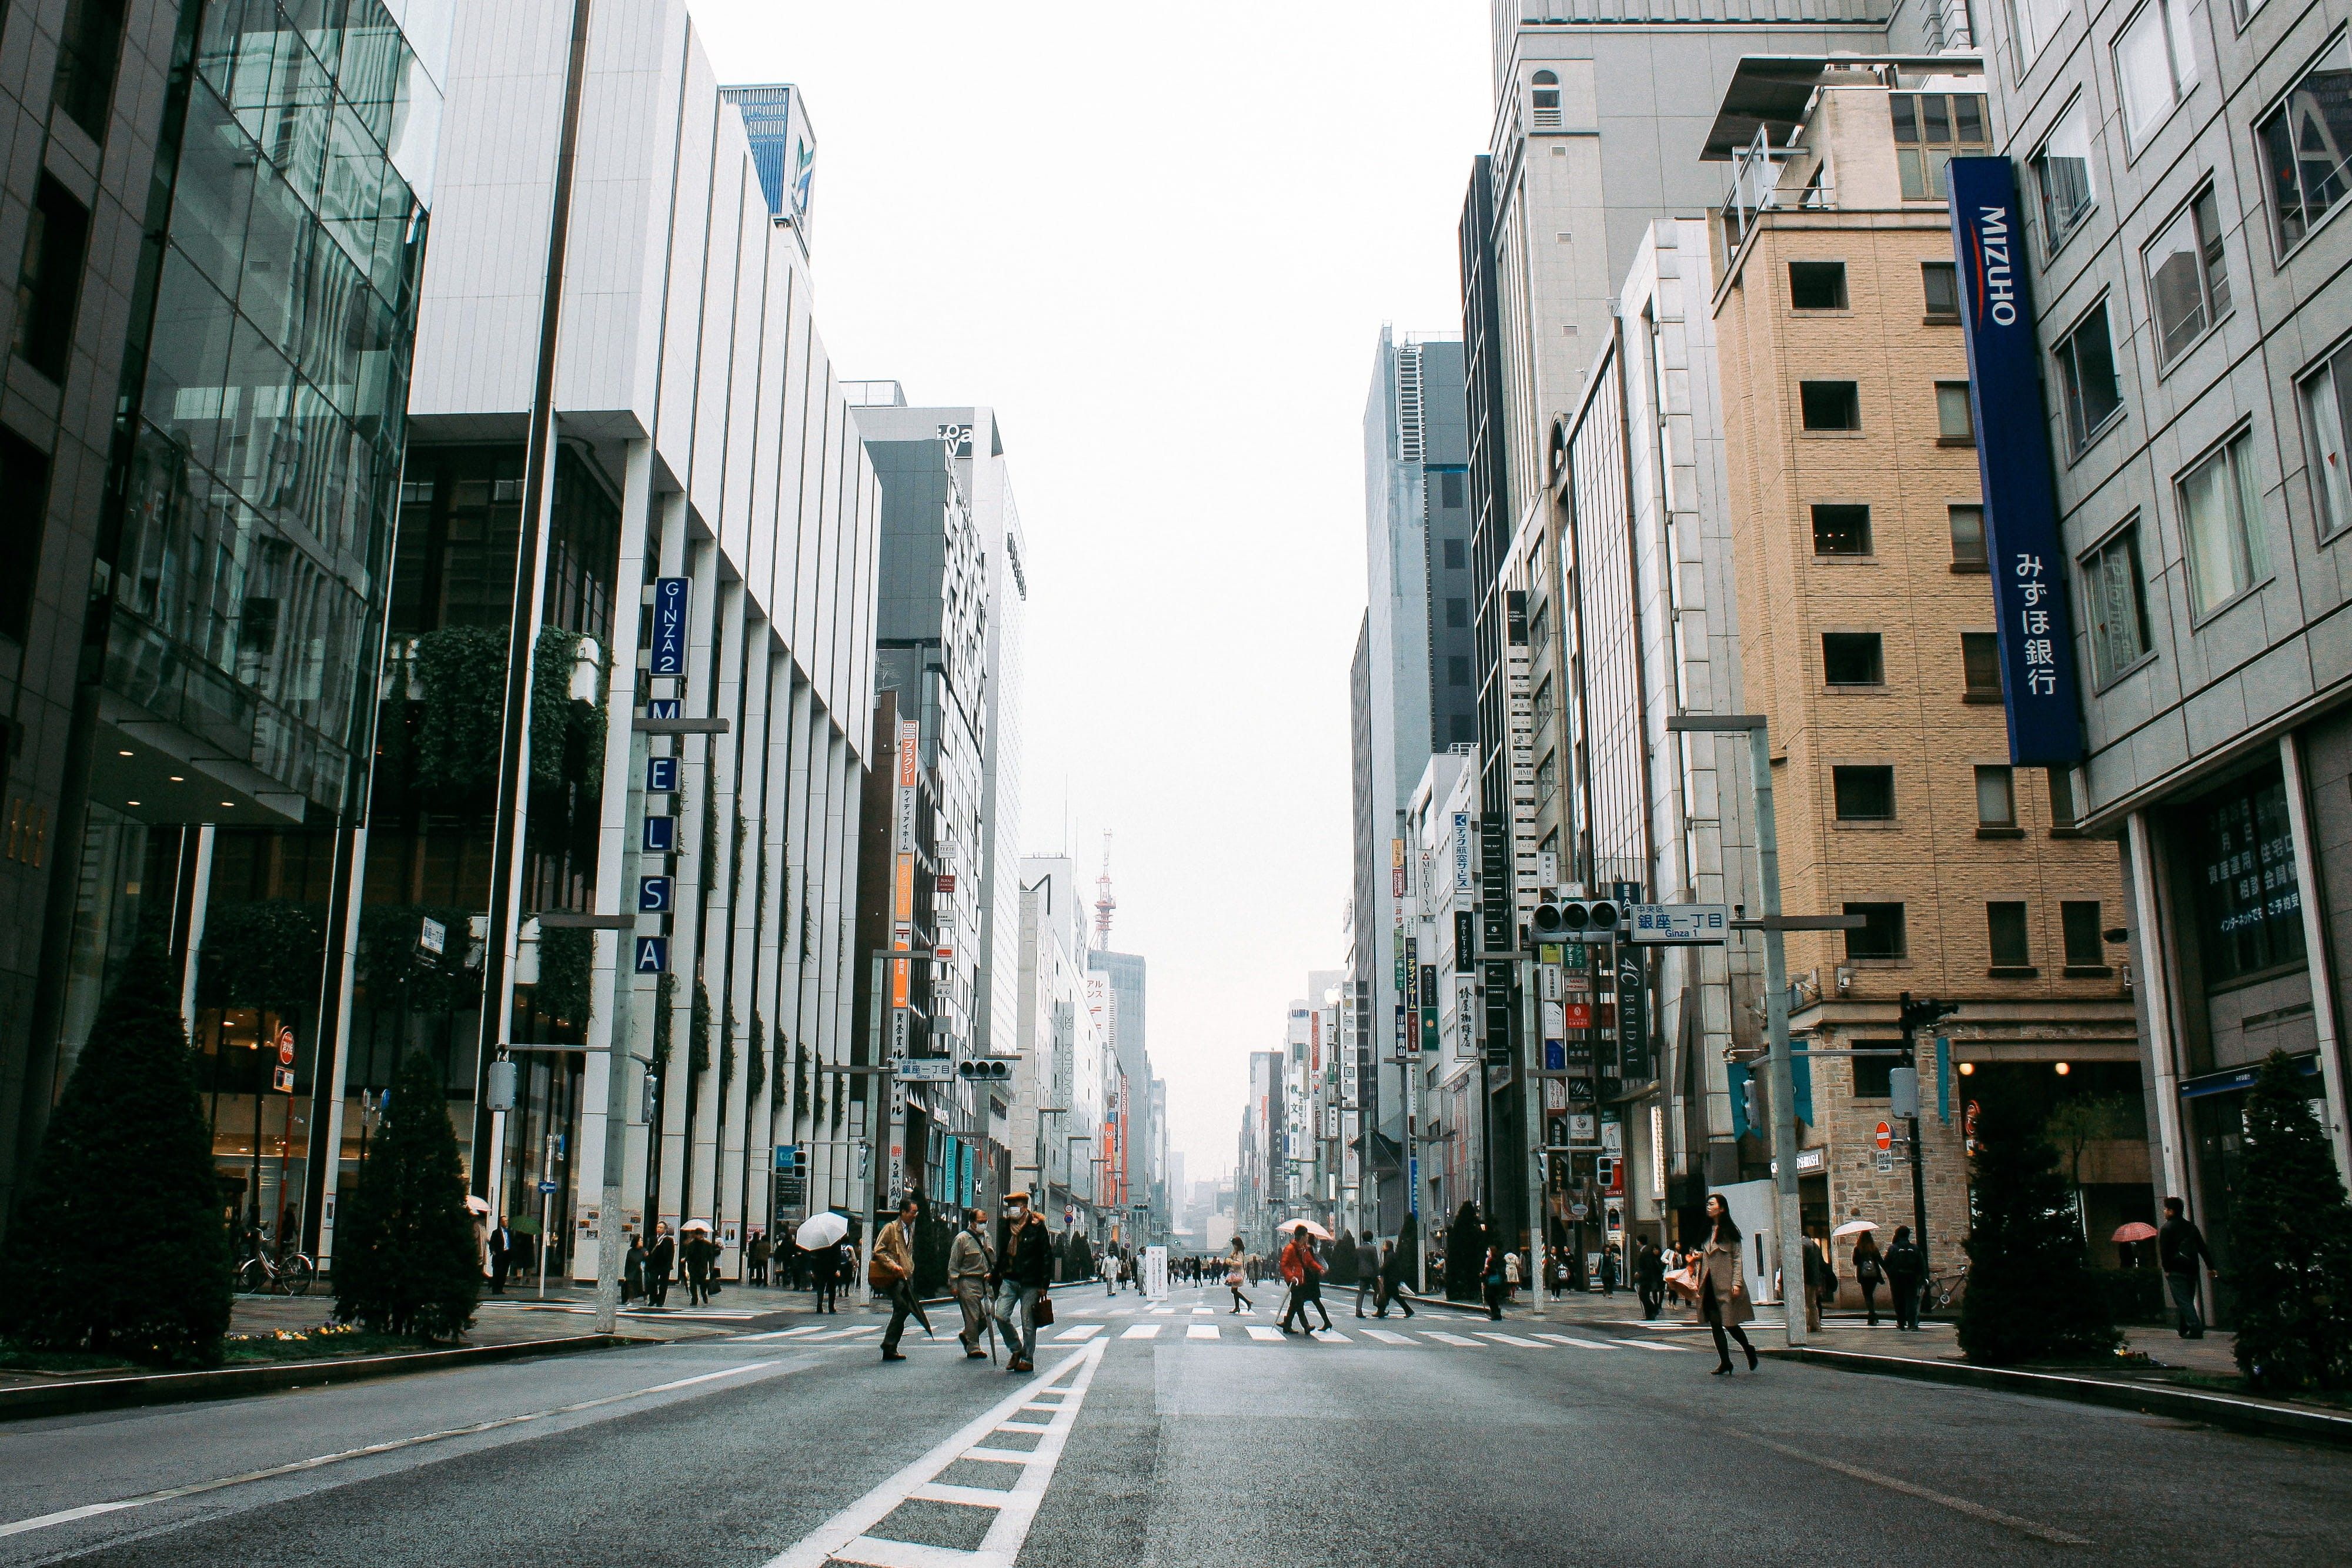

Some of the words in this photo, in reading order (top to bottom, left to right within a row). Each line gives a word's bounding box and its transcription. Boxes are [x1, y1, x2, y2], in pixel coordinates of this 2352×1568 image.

[1979, 206, 2016, 326] MIZUHO
[2016, 553, 2056, 696] みずほ銀行
[1456, 827, 1468, 887] テック航空サービス
[1422, 860, 1431, 913] MEIDI-YA
[1638, 914, 1722, 929] 銀座一丁目
[1665, 929, 1690, 937] Ginza
[1624, 995, 1638, 1066] BRIDAL
[902, 1065, 950, 1074] 銀座一丁目
